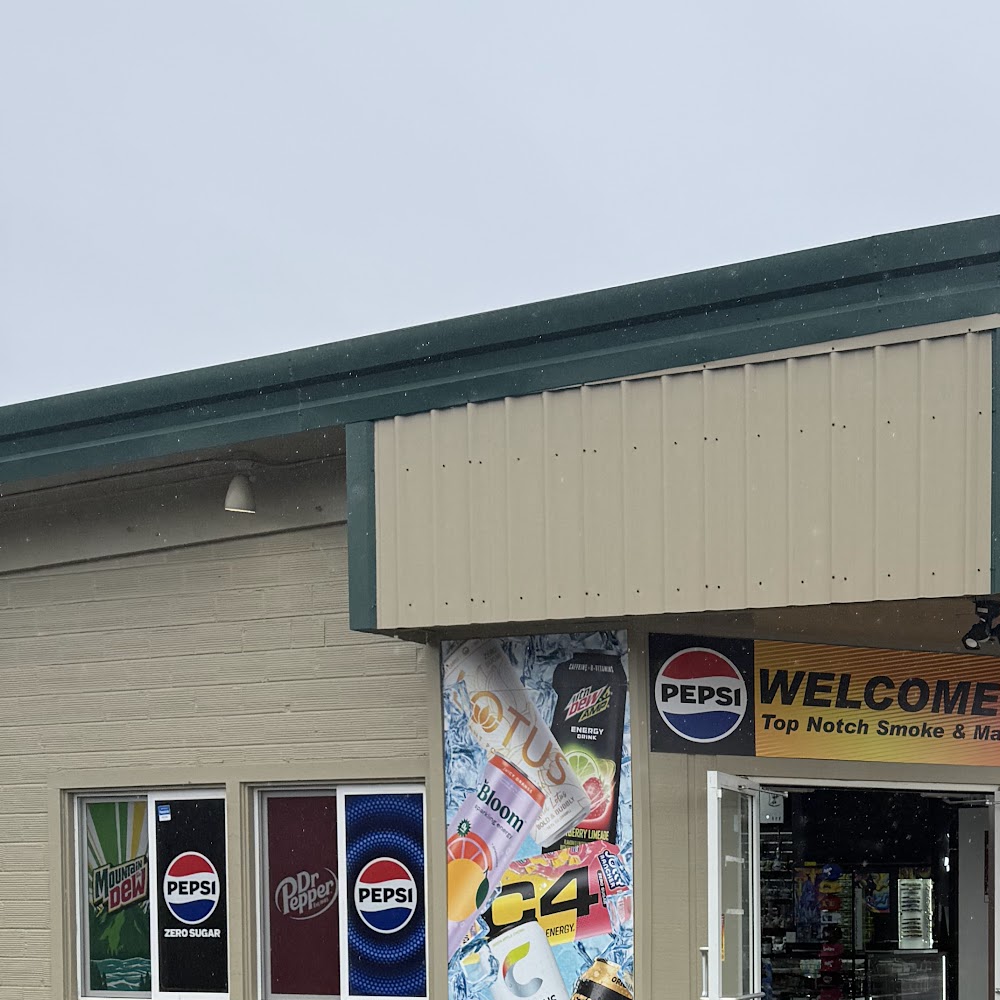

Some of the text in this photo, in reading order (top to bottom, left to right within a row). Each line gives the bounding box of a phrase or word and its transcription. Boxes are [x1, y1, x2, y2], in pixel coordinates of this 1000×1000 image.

[662, 683, 741, 707] PEPSI
[759, 668, 999, 717] WELCOME
[464, 687, 569, 786] OTUS
[570, 725, 604, 736] ENERGY
[576, 733, 598, 741] DRINK
[761, 713, 799, 735] Top
[807, 716, 869, 735] Notch
[876, 719, 945, 739] Smoke
[952, 724, 966, 740] &
[477, 780, 524, 834] Bloom
[588, 829, 609, 841] LIMEADE
[296, 871, 320, 894] Dr
[600, 854, 616, 888] RANCHER
[167, 881, 216, 896] PEPSI
[276, 876, 335, 915] Pepper
[358, 887, 413, 903] PEPSI
[164, 928, 221, 938] ZERO SUGAR
